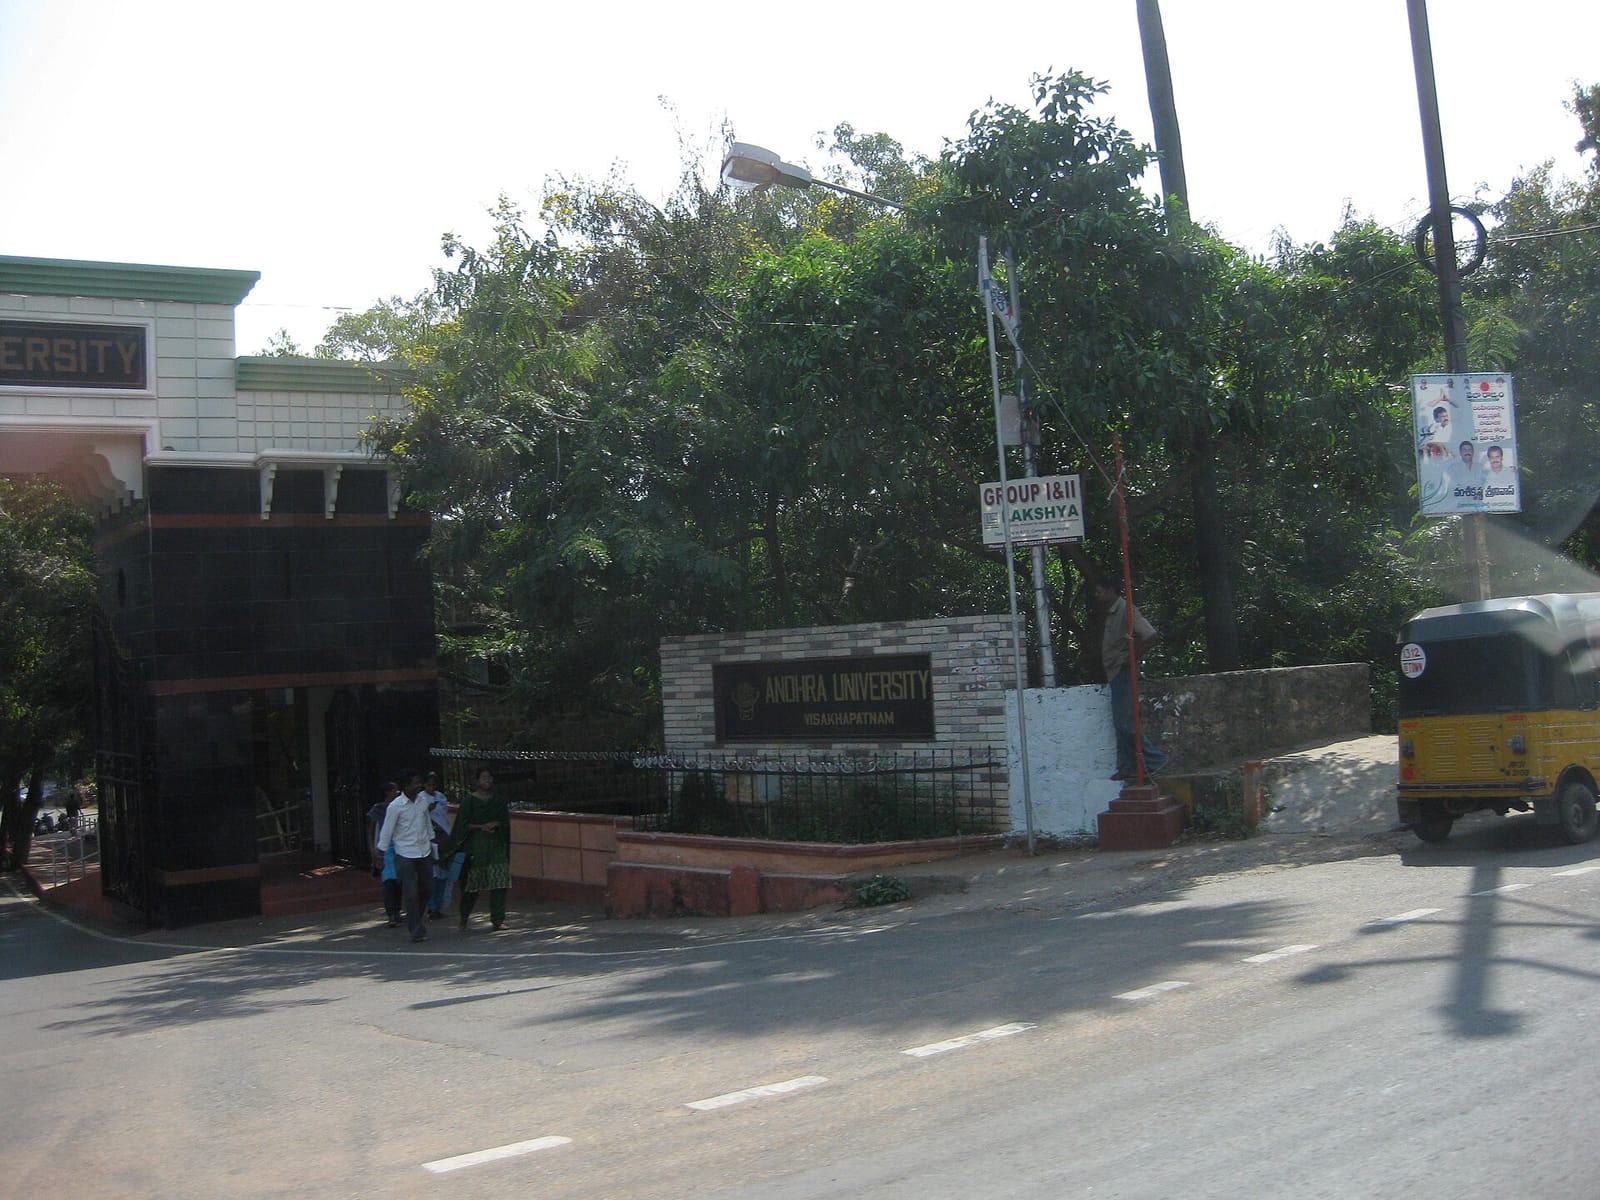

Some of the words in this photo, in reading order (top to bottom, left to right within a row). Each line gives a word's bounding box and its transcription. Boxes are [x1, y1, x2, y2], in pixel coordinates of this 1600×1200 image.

[0, 336, 137, 375] ERSITY
[766, 674, 827, 703] ANDHRA
[833, 671, 929, 700] UNIVERSITY
[805, 712, 894, 726] VISAKHAPATNAM
